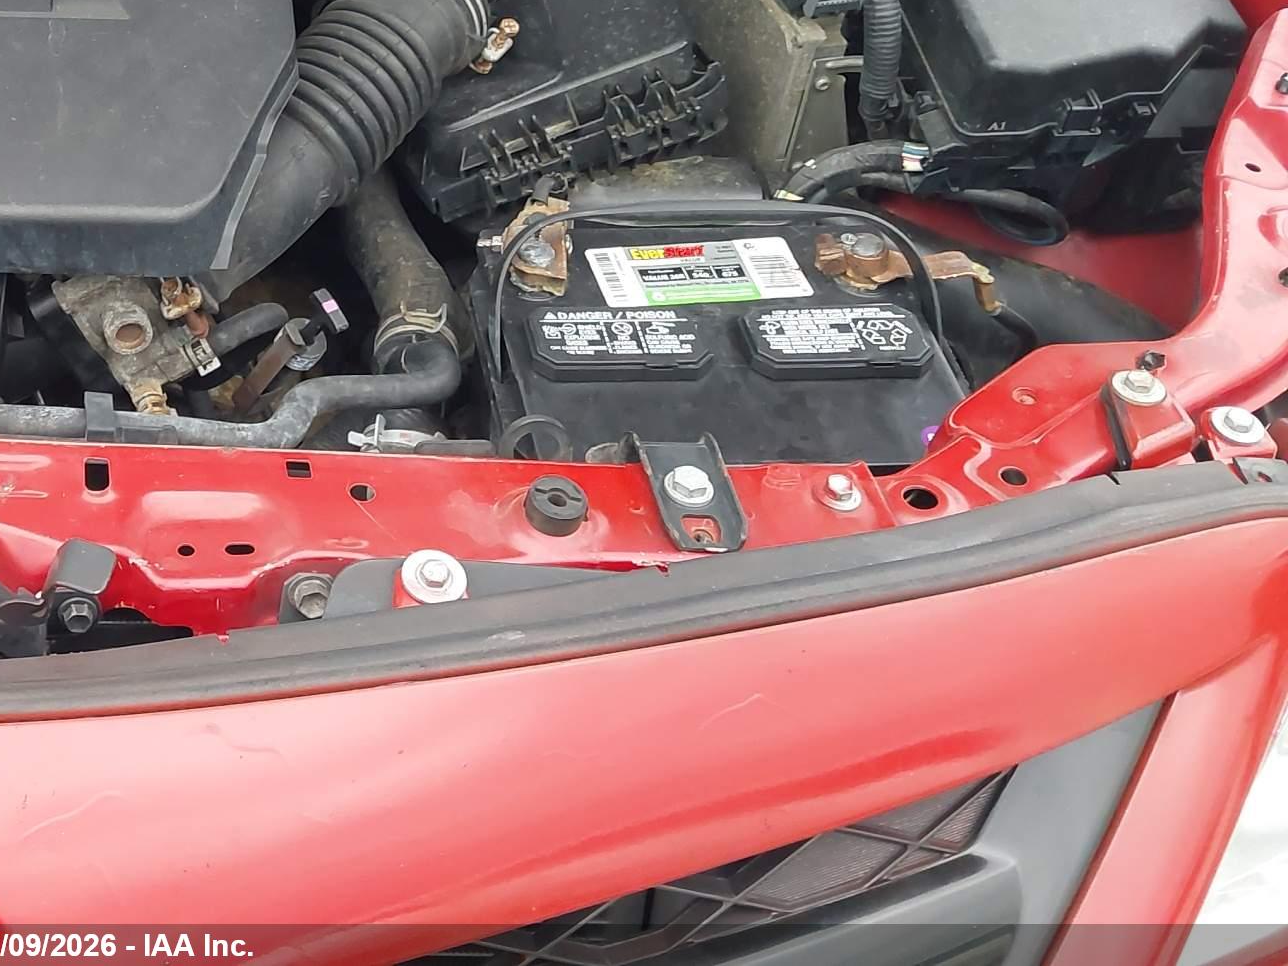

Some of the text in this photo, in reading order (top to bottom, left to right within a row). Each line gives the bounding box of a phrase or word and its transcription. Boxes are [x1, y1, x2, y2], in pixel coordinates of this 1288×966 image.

[629, 245, 704, 260] EverStart
[557, 310, 677, 320] DANGER / POISON
